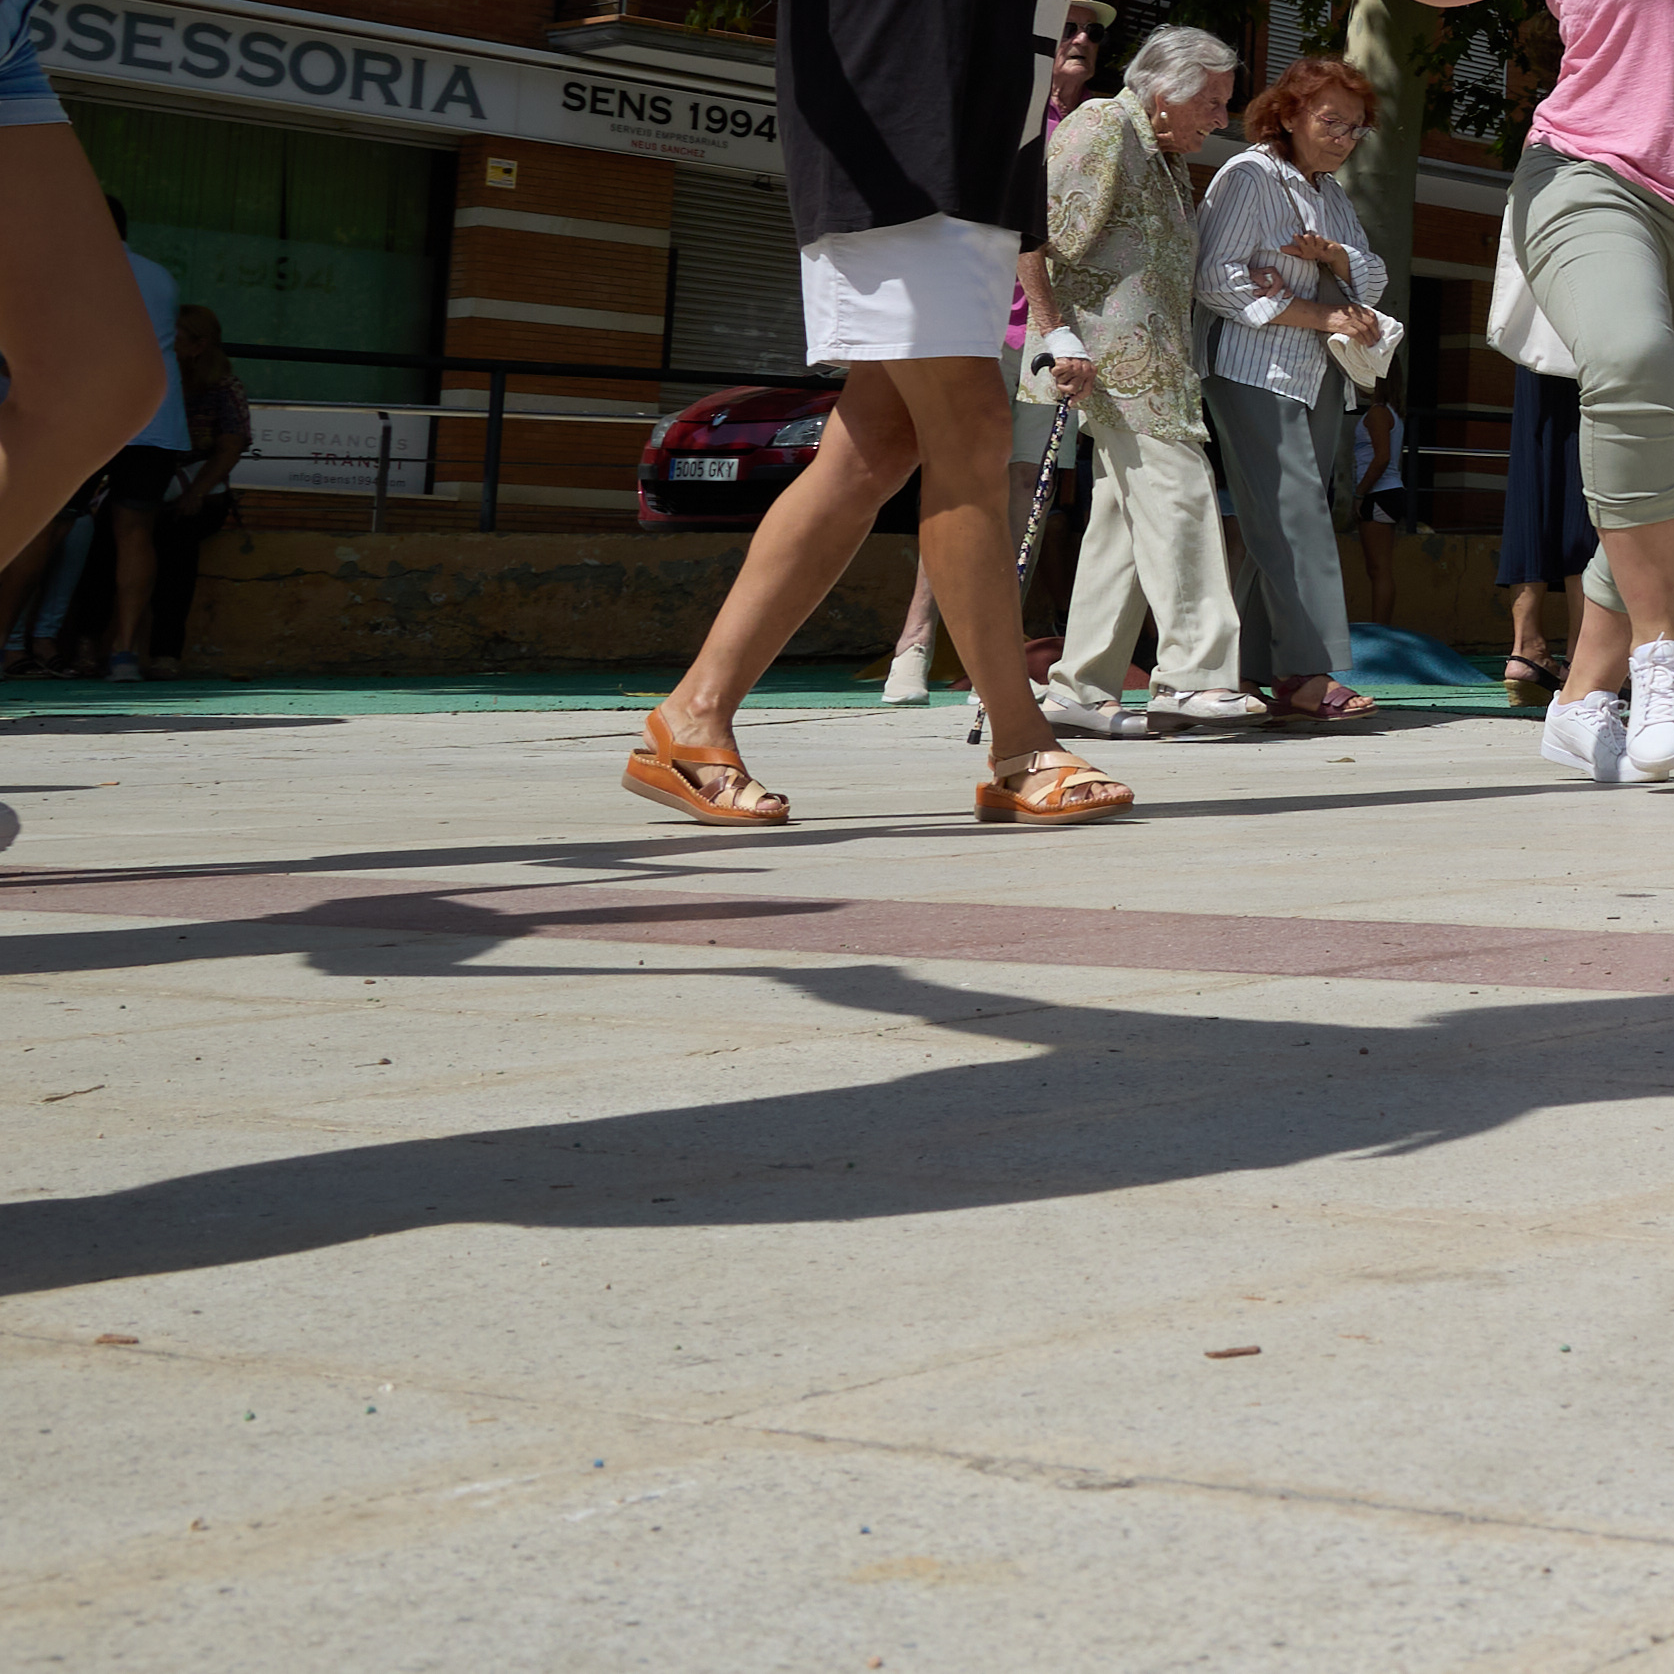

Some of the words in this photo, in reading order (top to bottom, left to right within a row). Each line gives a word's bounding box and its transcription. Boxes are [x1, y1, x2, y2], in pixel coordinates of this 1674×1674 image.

[562, 81, 673, 125] SENS
[689, 101, 777, 143] 1994
[609, 122, 653, 138] SERVEIS
[655, 129, 730, 149] EMPRESARIALS
[630, 139, 658, 151] NEUS
[660, 143, 706, 158] SANCHEZ
[250, 428, 409, 452] SEGURANCS
[676, 461, 704, 478] 5005
[708, 461, 735, 478] GKY
[288, 473, 406, 488] info@sens1994om
